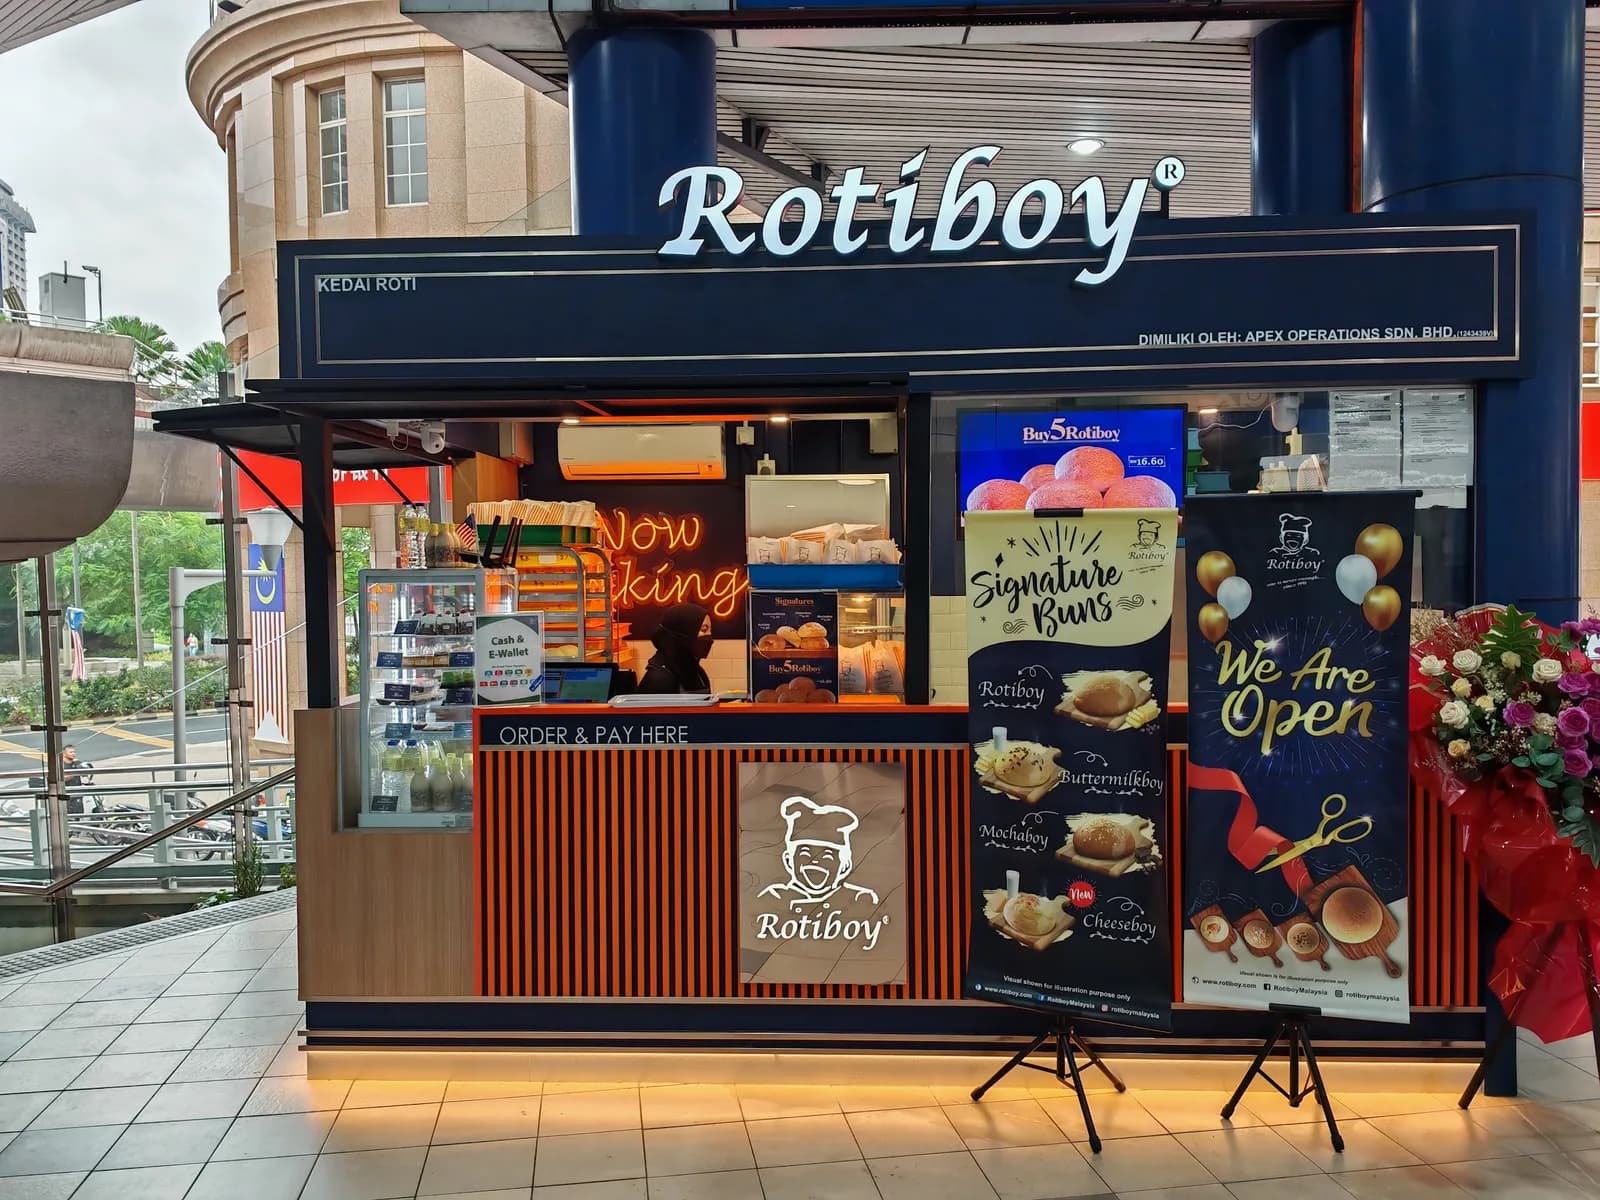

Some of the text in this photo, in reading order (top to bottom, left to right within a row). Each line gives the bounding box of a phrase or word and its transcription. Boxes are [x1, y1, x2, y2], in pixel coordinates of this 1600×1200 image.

[319, 277, 416, 292] KEDAI ROTI
[1139, 333, 1194, 345] DIMILIKI
[1198, 331, 1241, 344] OLEH:
[1245, 330, 1283, 342] APEX
[1288, 328, 1380, 341] OPERATIONS
[1384, 327, 1418, 339] SDN.
[1422, 326, 1456, 338] BHD.
[1023, 418, 1120, 442] Buy 5 Rotiboy
[594, 509, 699, 550] Now
[1266, 557, 1321, 573] Rotiboy
[971, 555, 1123, 613] Signature
[1033, 592, 1112, 637] Buns
[489, 648, 529, 659] E-Wallet
[491, 635, 525, 646] Cash &
[1215, 640, 1376, 693] We Are
[979, 679, 1044, 706] Rotiboy
[1221, 684, 1373, 755] Open
[500, 725, 689, 745] ORDER & PAY HERE
[1058, 769, 1163, 796] Buttermilkboy
[979, 824, 1048, 851] Mochaboy
[1083, 911, 1156, 940] Cheeseboy
[1003, 975, 1022, 984] Visual
[1023, 979, 1043, 987] shown
[1054, 983, 1088, 995] illustration
[1089, 989, 1115, 999] purpose
[1116, 993, 1131, 1002] only
[1203, 979, 1400, 1002] www.rotiboy.com RotiboyMalaysia rotiboymalaysia
[984, 986, 1160, 1019] www.rotiboy.com RotiboyMalaysia rotiboymalaysia
